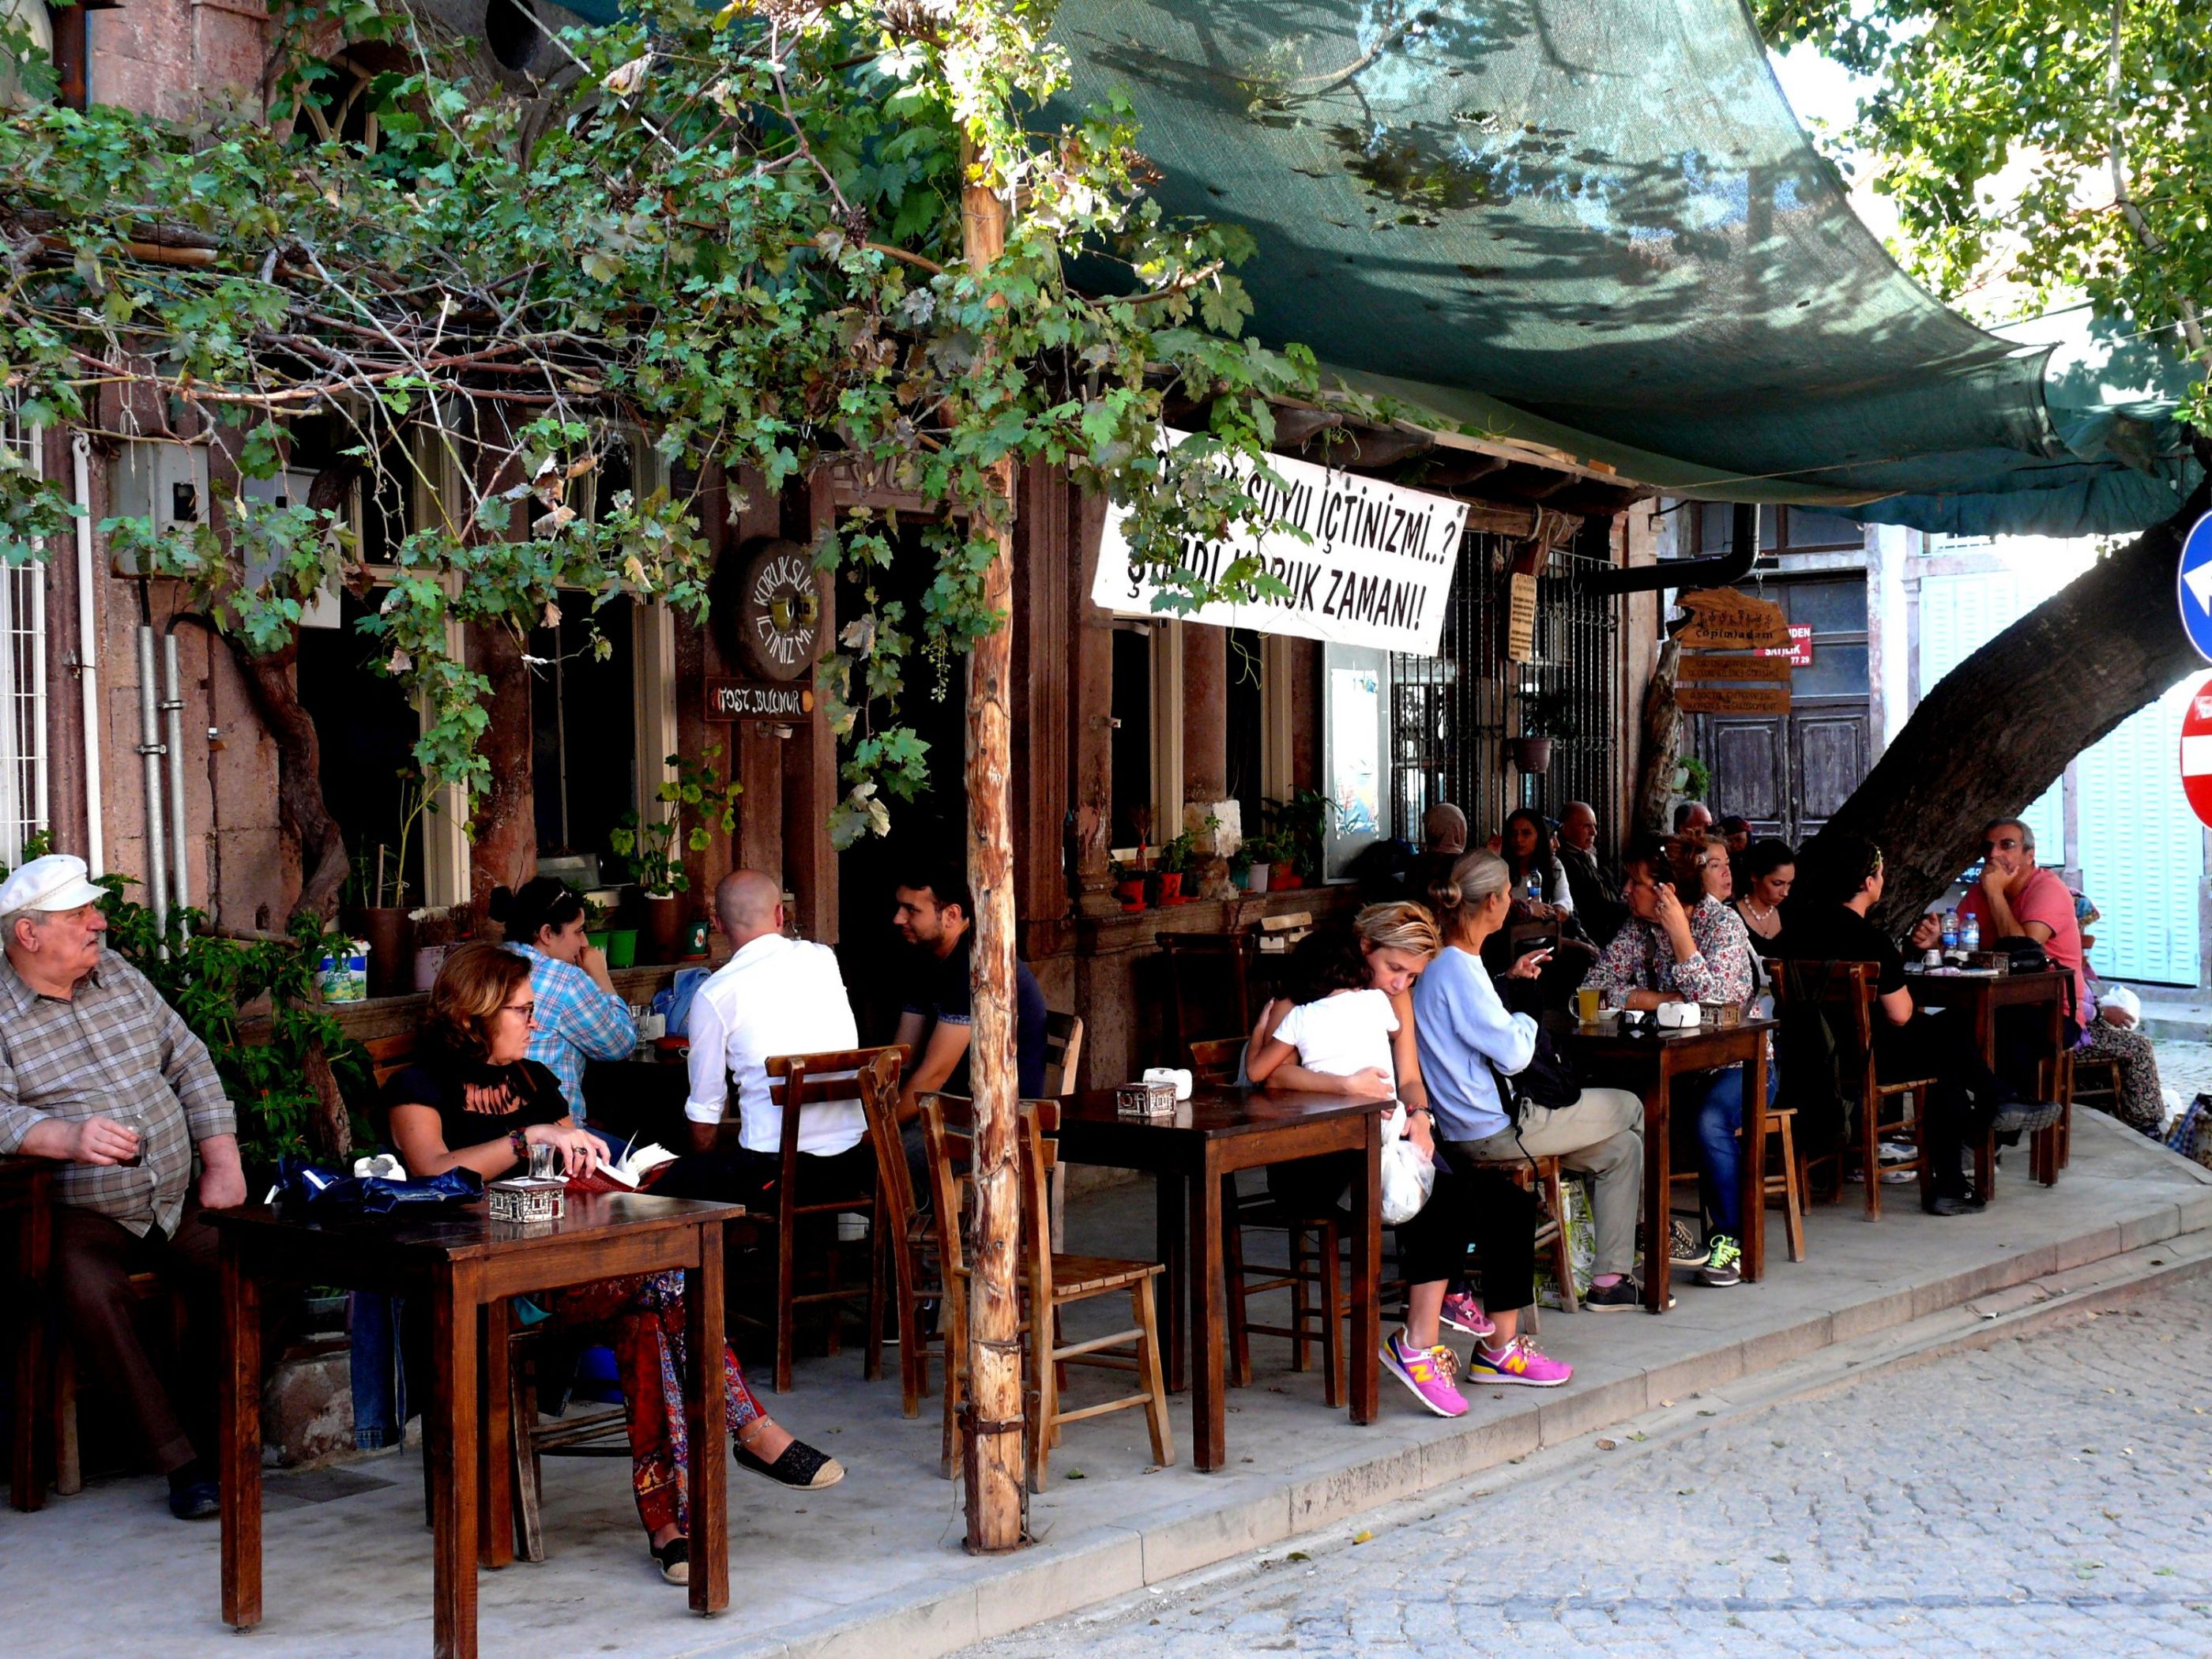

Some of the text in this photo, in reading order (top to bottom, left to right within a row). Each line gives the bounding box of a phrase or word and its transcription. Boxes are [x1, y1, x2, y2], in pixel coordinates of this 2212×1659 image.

[754, 555, 790, 606] KORUK
[1322, 569, 1427, 631] ZAMANI!
[720, 687, 751, 714] TOST
